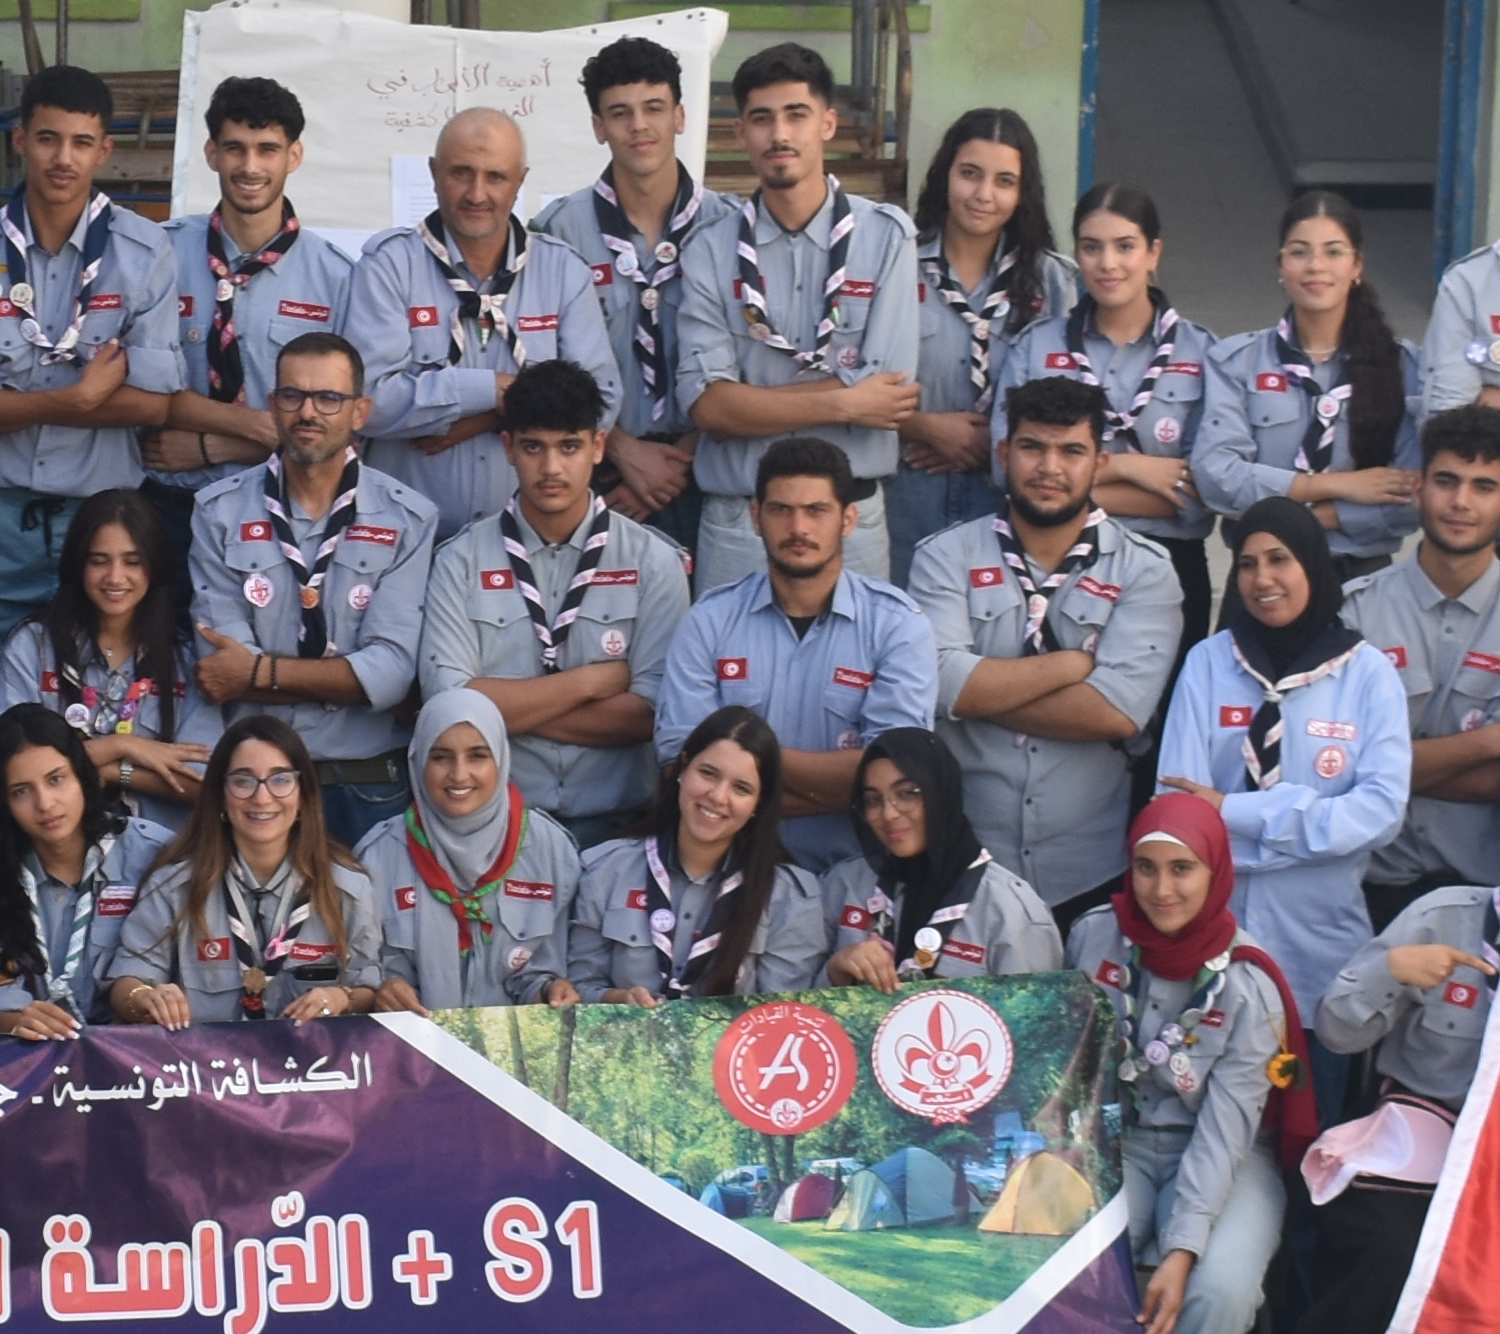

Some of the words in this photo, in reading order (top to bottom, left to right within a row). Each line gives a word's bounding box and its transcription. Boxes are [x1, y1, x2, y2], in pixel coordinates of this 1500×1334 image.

[53, 1063, 200, 1120] التونسية
[212, 1051, 373, 1099] الكشافة
[484, 1196, 603, 1303] S1
